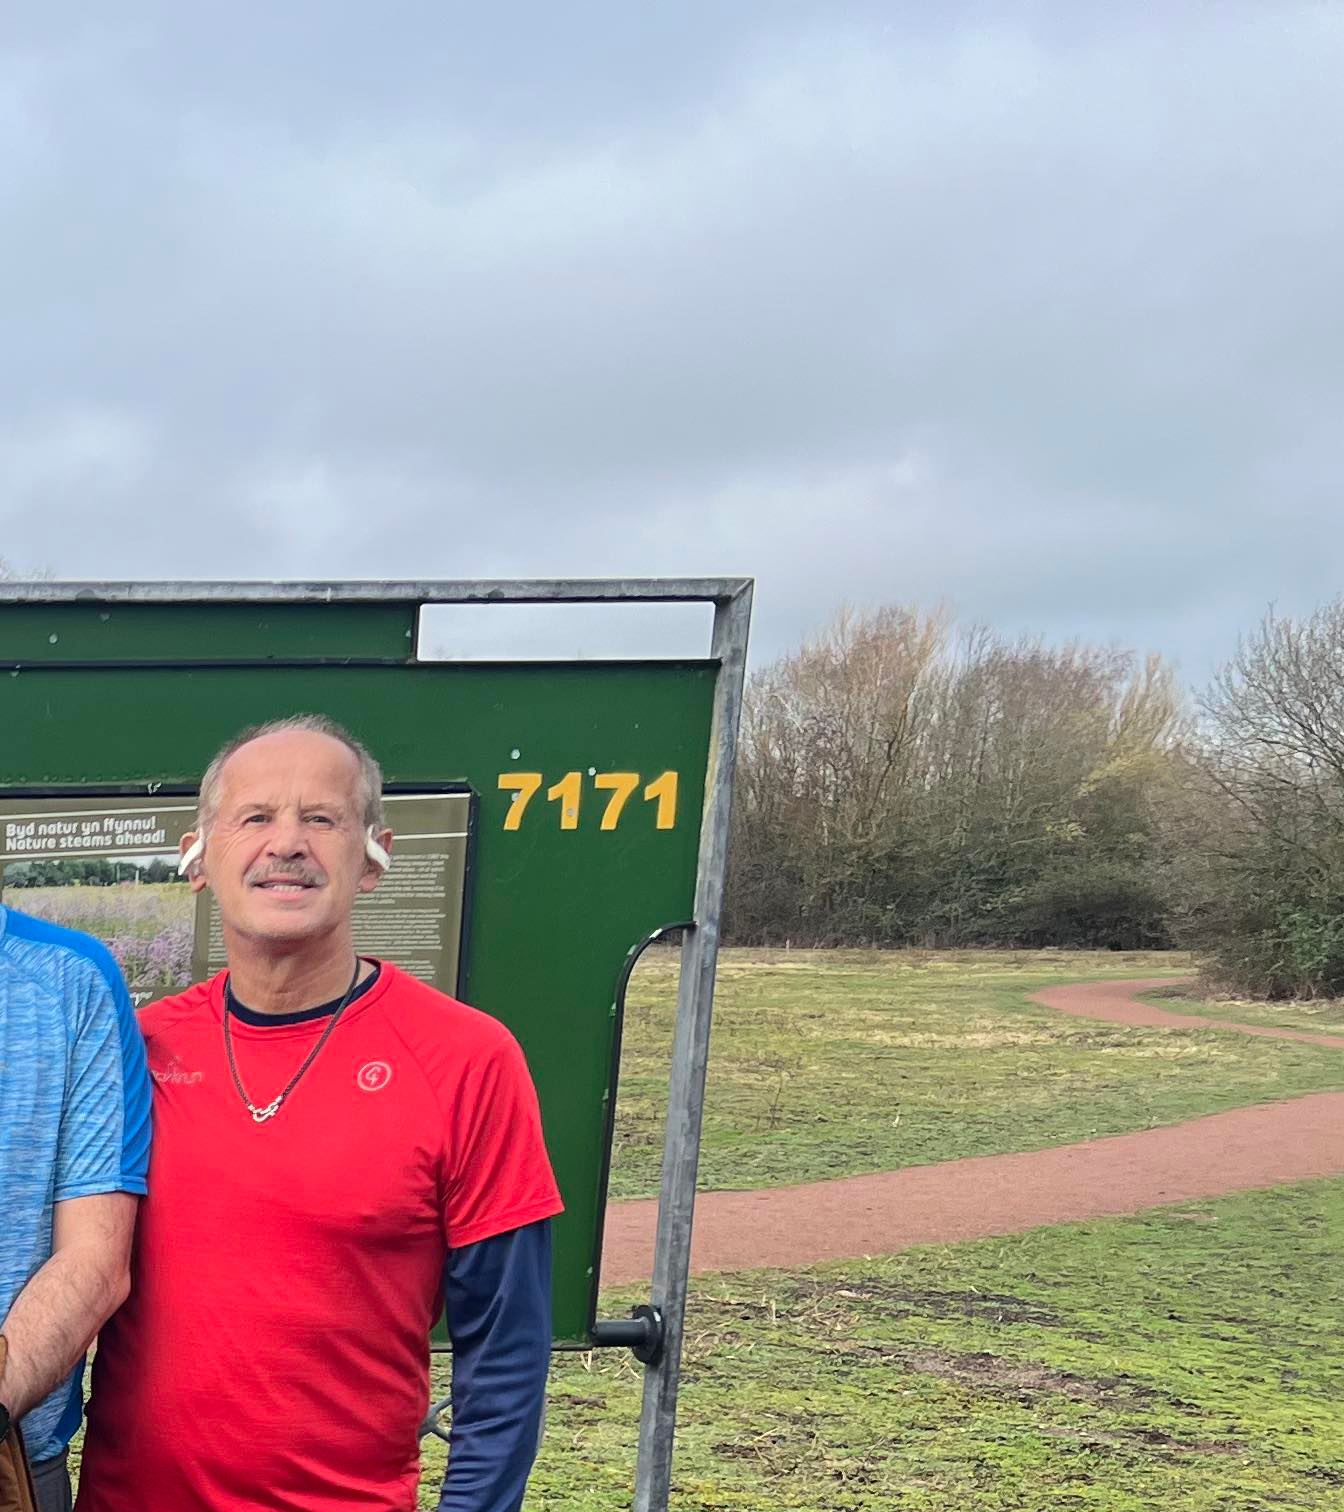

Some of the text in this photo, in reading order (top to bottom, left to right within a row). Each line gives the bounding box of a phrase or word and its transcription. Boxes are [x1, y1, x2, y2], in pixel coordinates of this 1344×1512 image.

[497, 771, 679, 831] 7171
[6, 816, 156, 838] Byd natur yn ffynnu!
[6, 829, 166, 851] Nature steams ahead!
